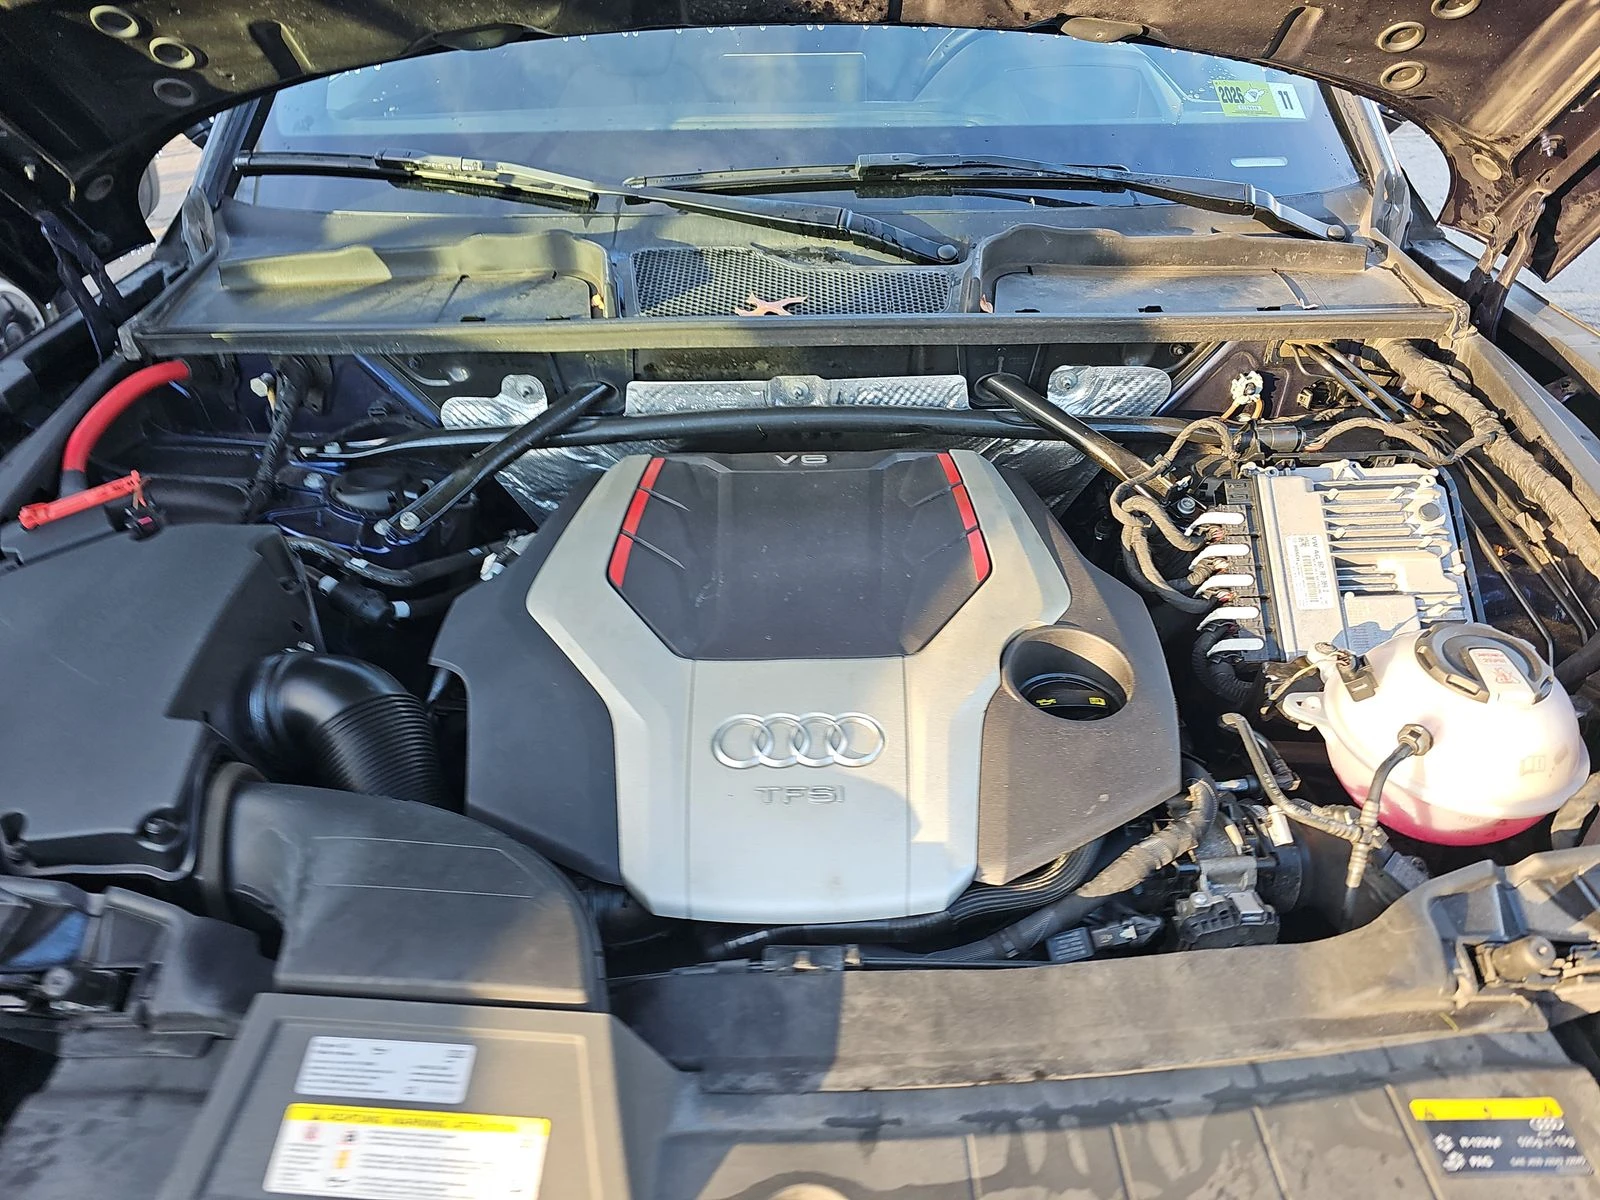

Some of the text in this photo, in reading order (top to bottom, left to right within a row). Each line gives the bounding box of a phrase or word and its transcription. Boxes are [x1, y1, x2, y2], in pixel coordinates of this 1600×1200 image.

[1218, 86, 1245, 104] 2026
[1277, 90, 1294, 110] 11
[774, 454, 828, 465] V6
[754, 786, 845, 804] TFSI
